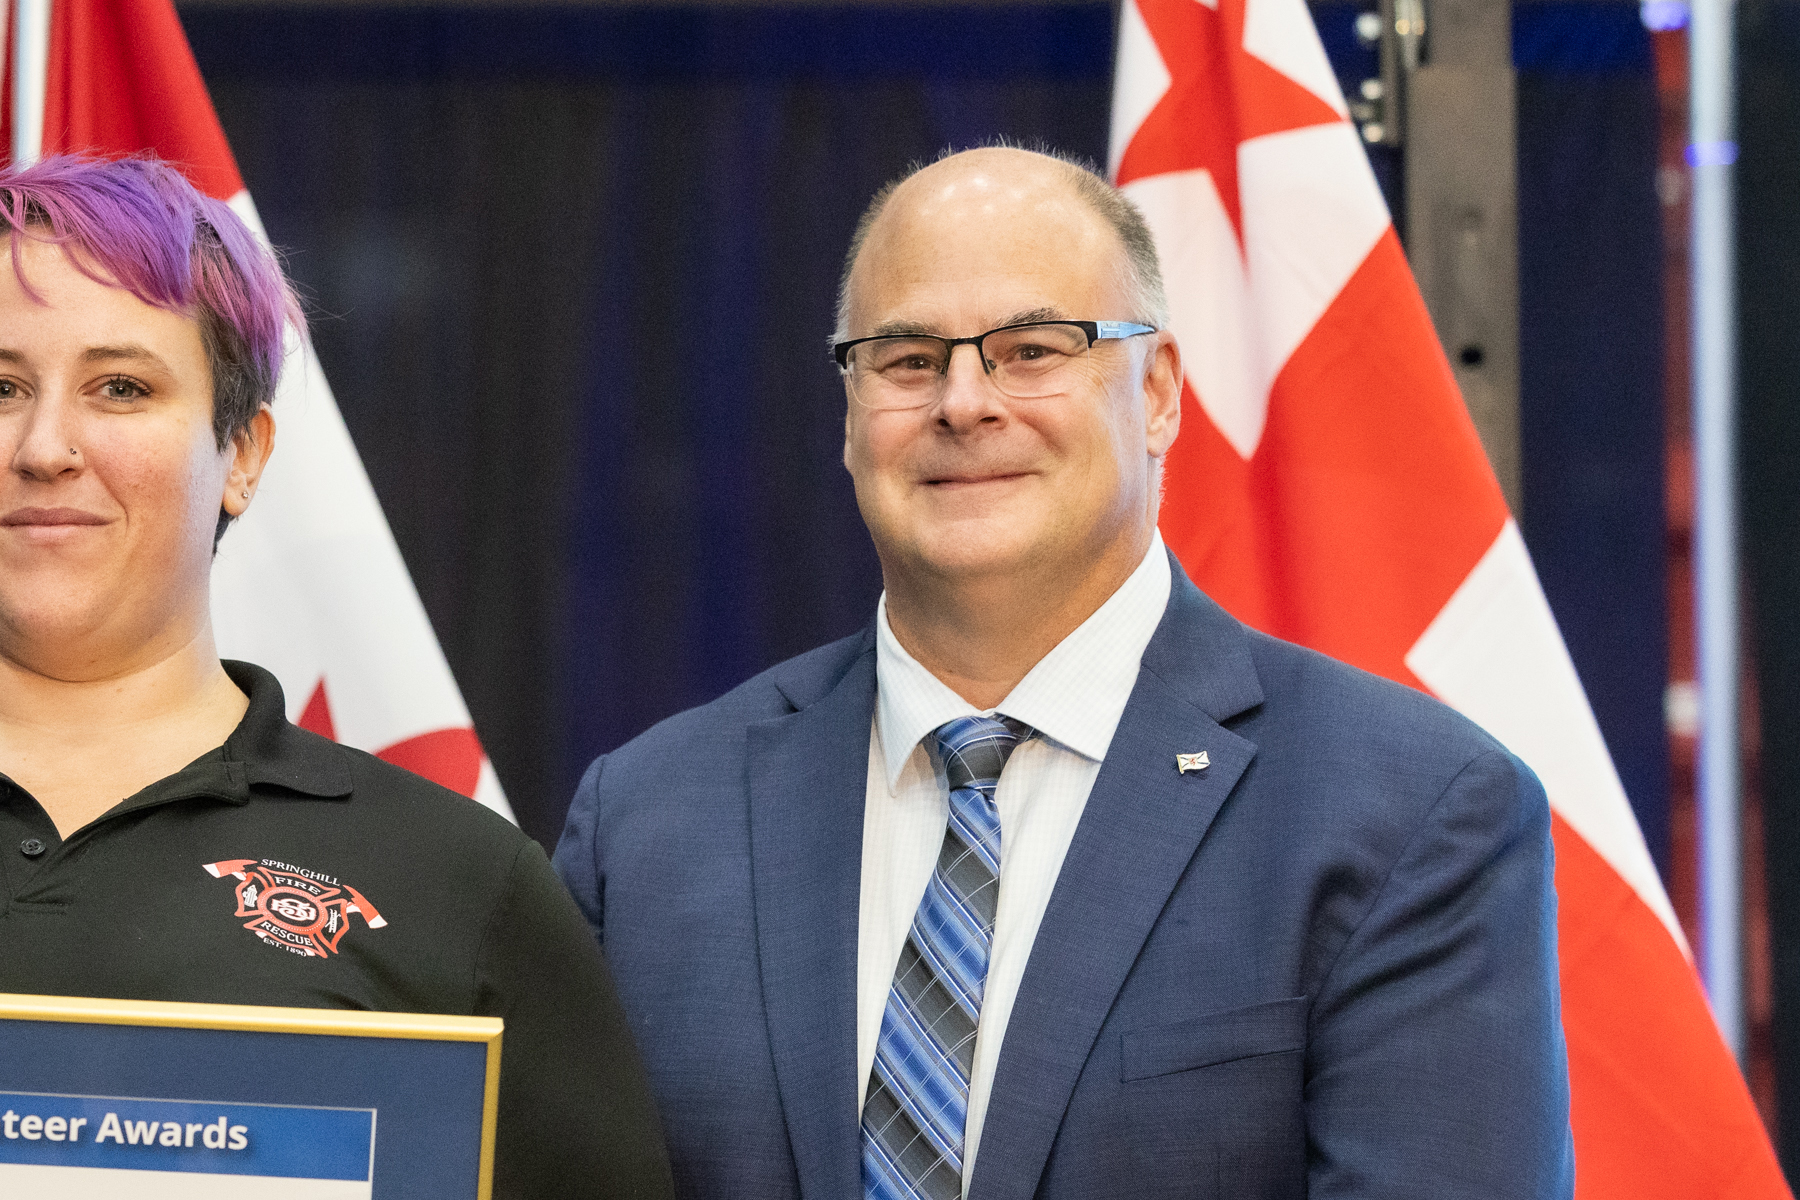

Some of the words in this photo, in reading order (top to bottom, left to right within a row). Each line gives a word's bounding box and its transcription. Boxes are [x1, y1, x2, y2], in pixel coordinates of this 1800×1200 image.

[260, 858, 341, 887] SPRINGHILL
[274, 876, 321, 895] FIRE
[260, 921, 314, 946] RESCUE
[263, 937, 283, 949] EST.
[286, 945, 307, 957] 1890
[95, 1112, 249, 1151] Awards
